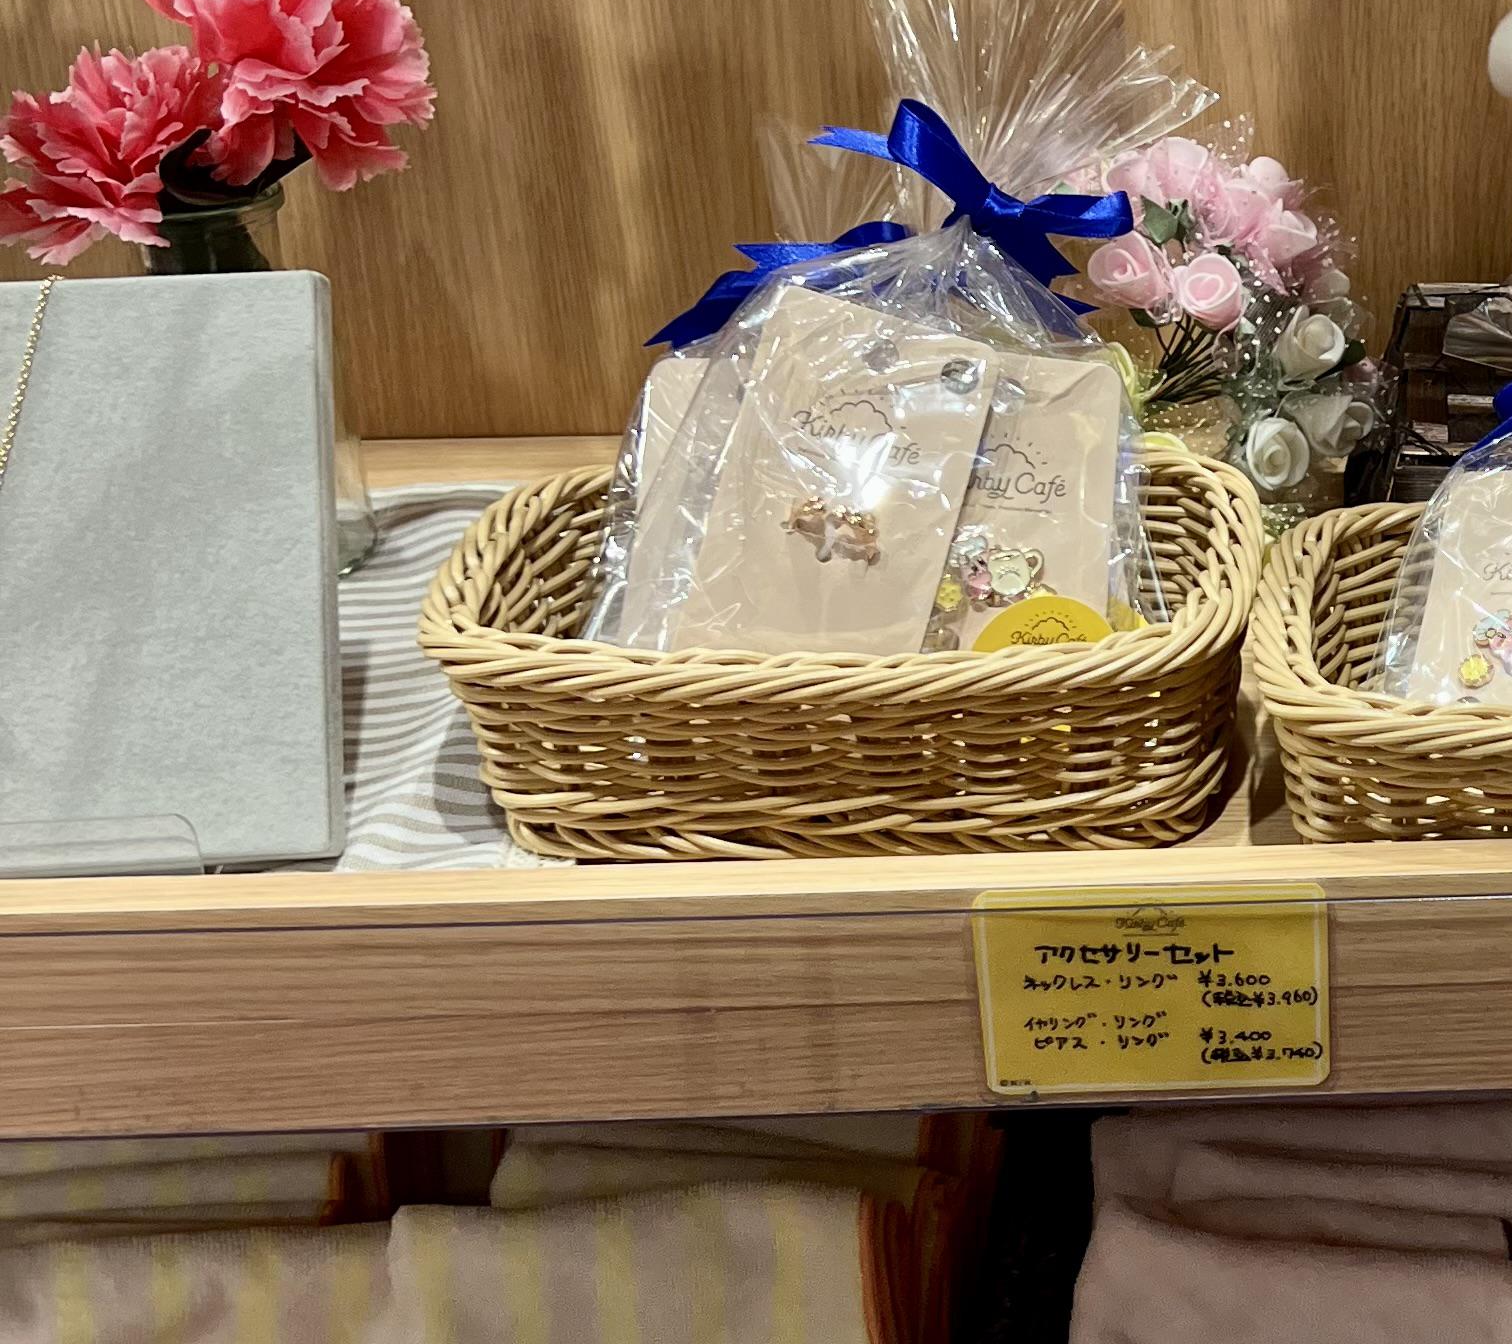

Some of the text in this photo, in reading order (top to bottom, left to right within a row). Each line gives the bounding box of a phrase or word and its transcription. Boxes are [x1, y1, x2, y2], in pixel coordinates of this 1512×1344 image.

[1015, 472, 1067, 503] Café
[1034, 942, 1235, 965] アクセサリーセット
